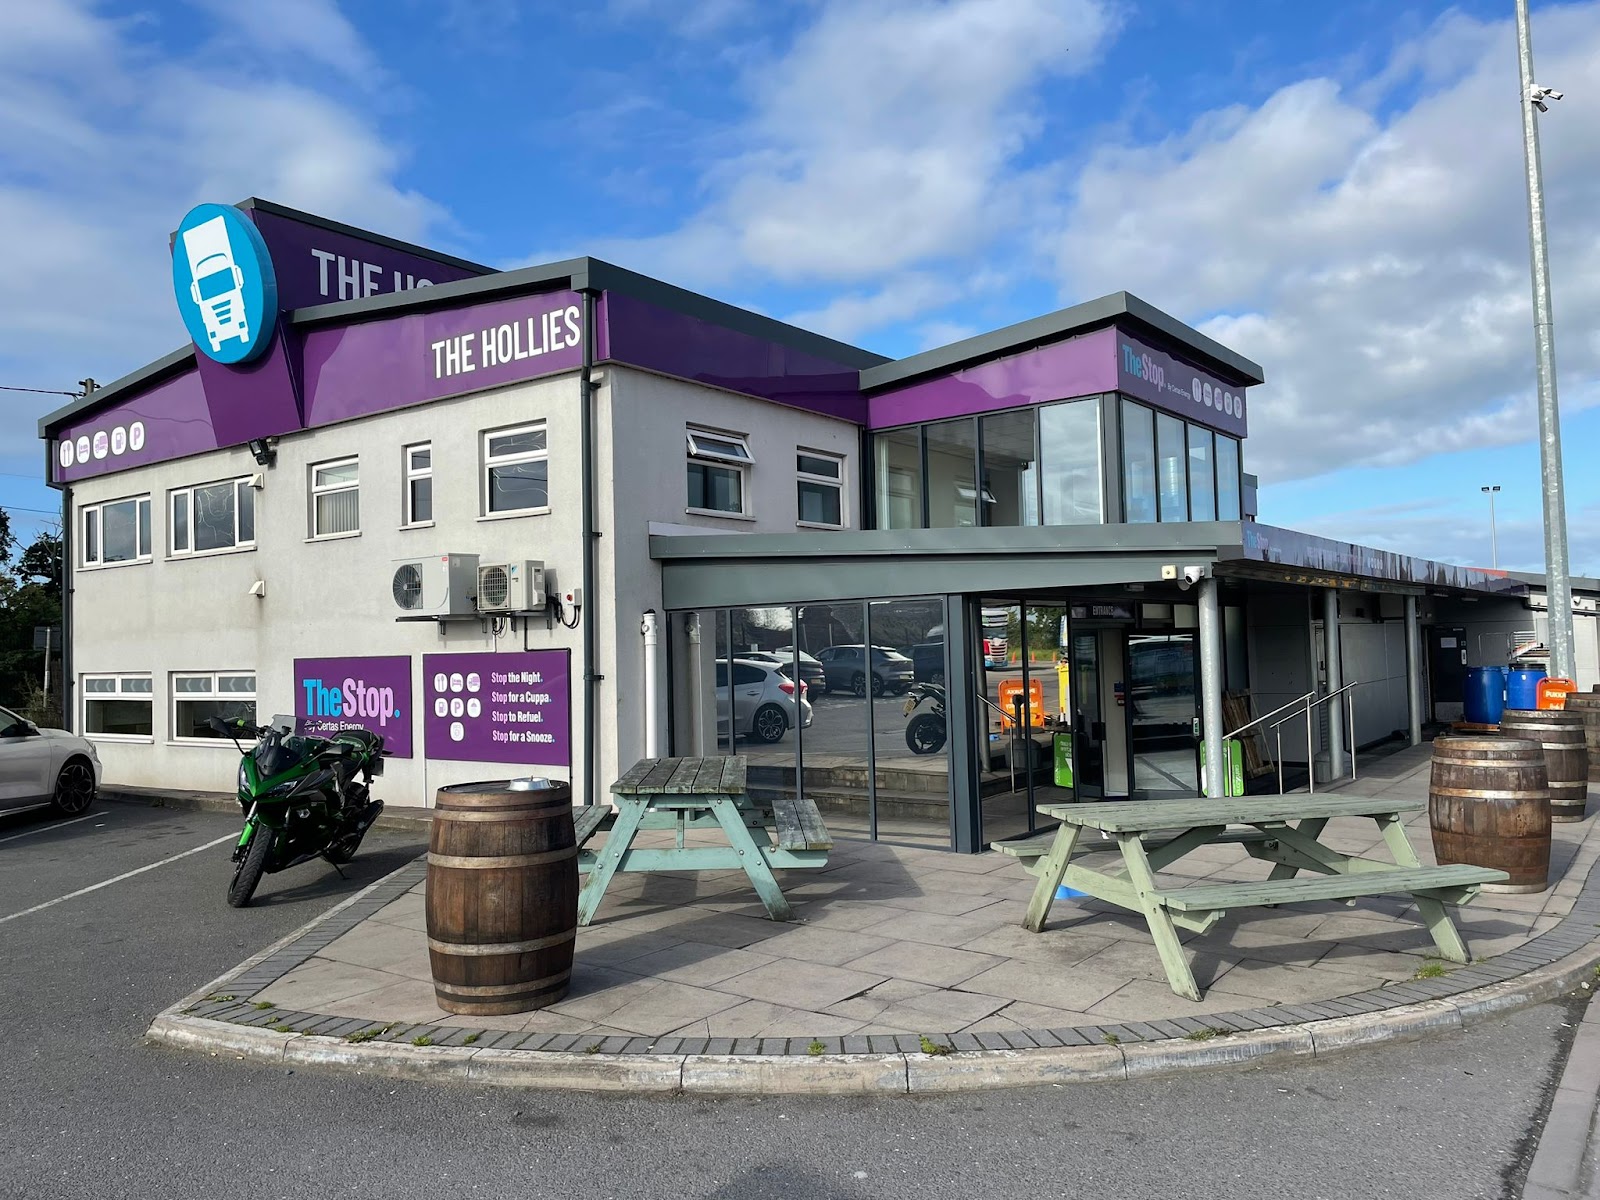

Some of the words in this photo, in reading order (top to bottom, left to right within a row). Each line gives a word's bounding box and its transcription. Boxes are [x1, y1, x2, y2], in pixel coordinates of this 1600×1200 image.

[312, 249, 382, 300] THE
[432, 333, 475, 379] THE
[482, 306, 580, 368] HOLLIES
[492, 672, 507, 685] Stop
[508, 672, 520, 683] the
[492, 692, 507, 705] Stop
[508, 692, 519, 702] for
[492, 711, 508, 724] Stop
[509, 712, 516, 722] to
[493, 730, 508, 743] Stop
[509, 730, 520, 742] for
[521, 733, 525, 742] a
